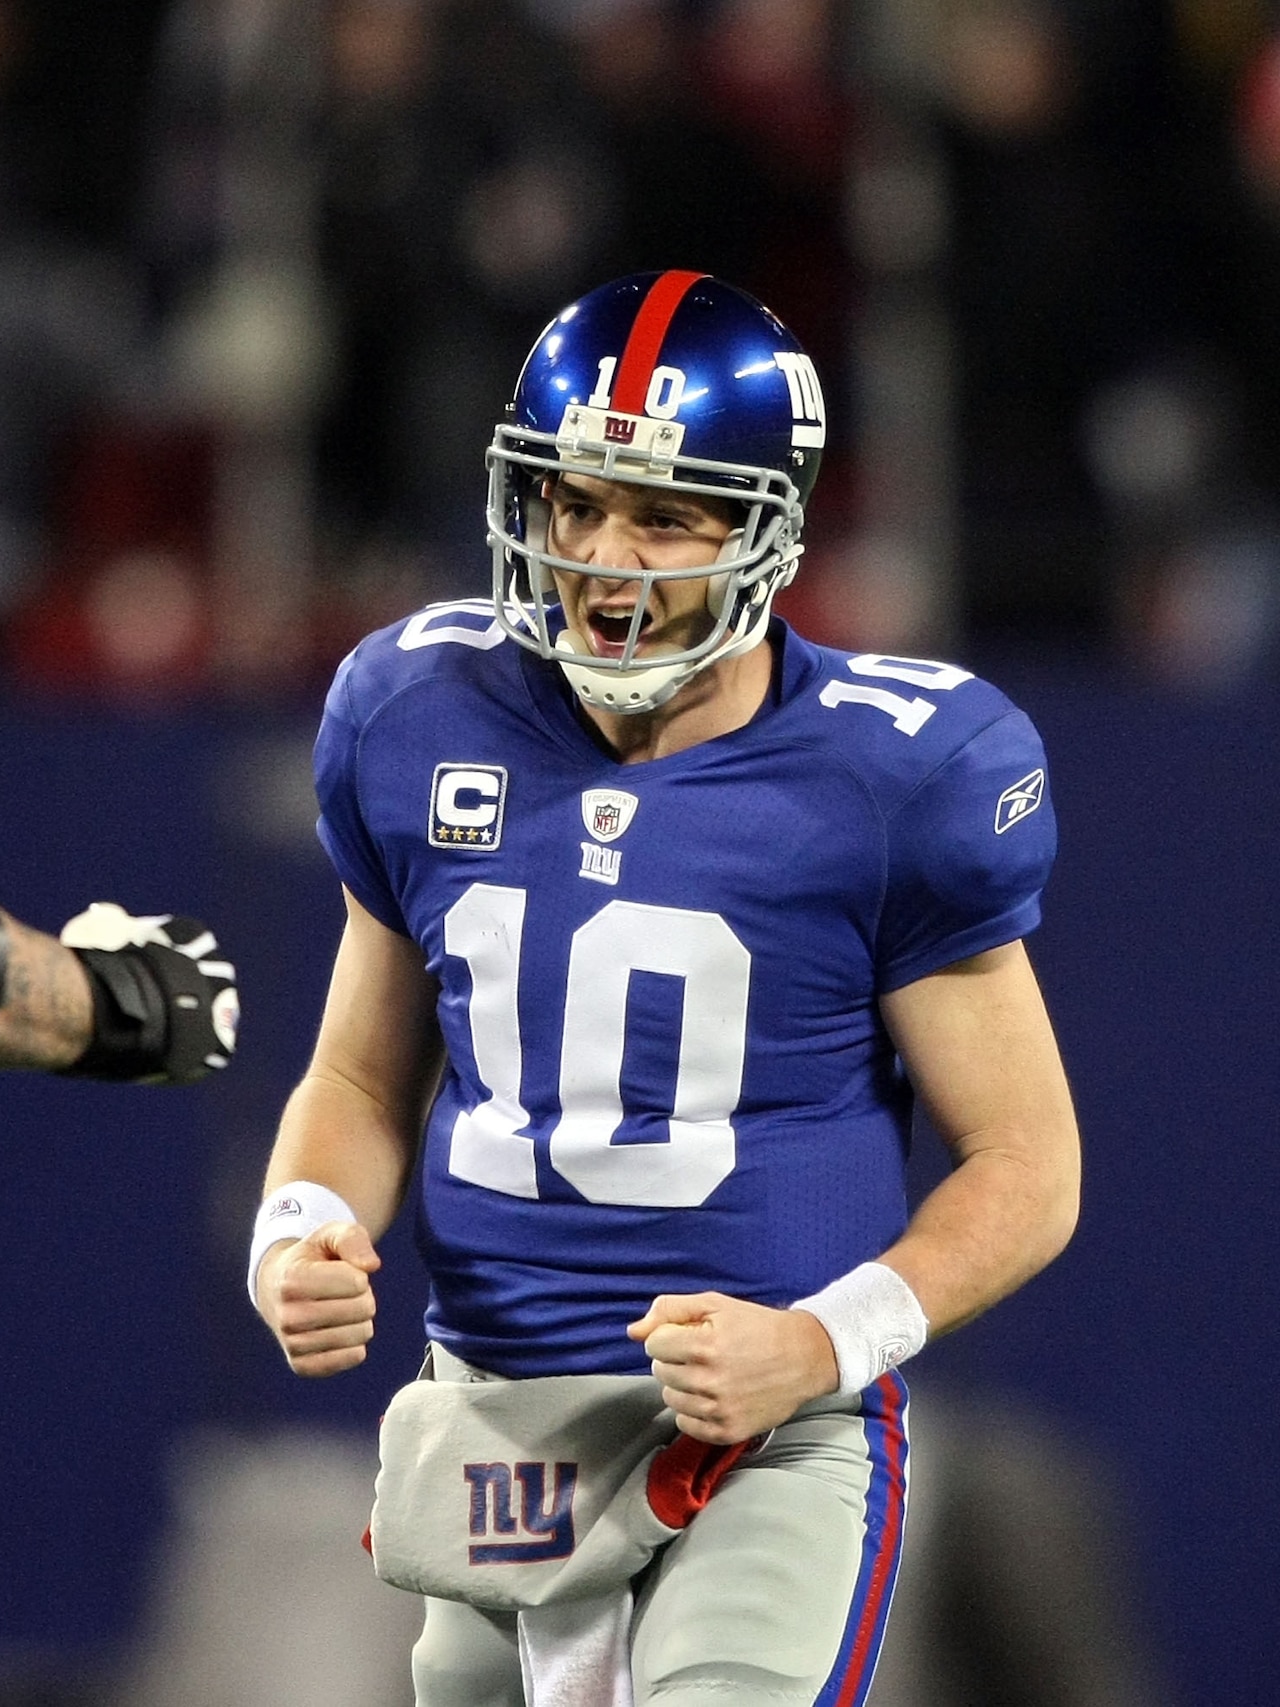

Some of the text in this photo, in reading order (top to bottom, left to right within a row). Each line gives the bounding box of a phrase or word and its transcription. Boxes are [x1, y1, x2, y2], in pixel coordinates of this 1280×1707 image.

[819, 653, 976, 737] 10
[436, 771, 499, 827] C
[595, 815, 618, 832] NFL
[444, 882, 751, 1207] 10
